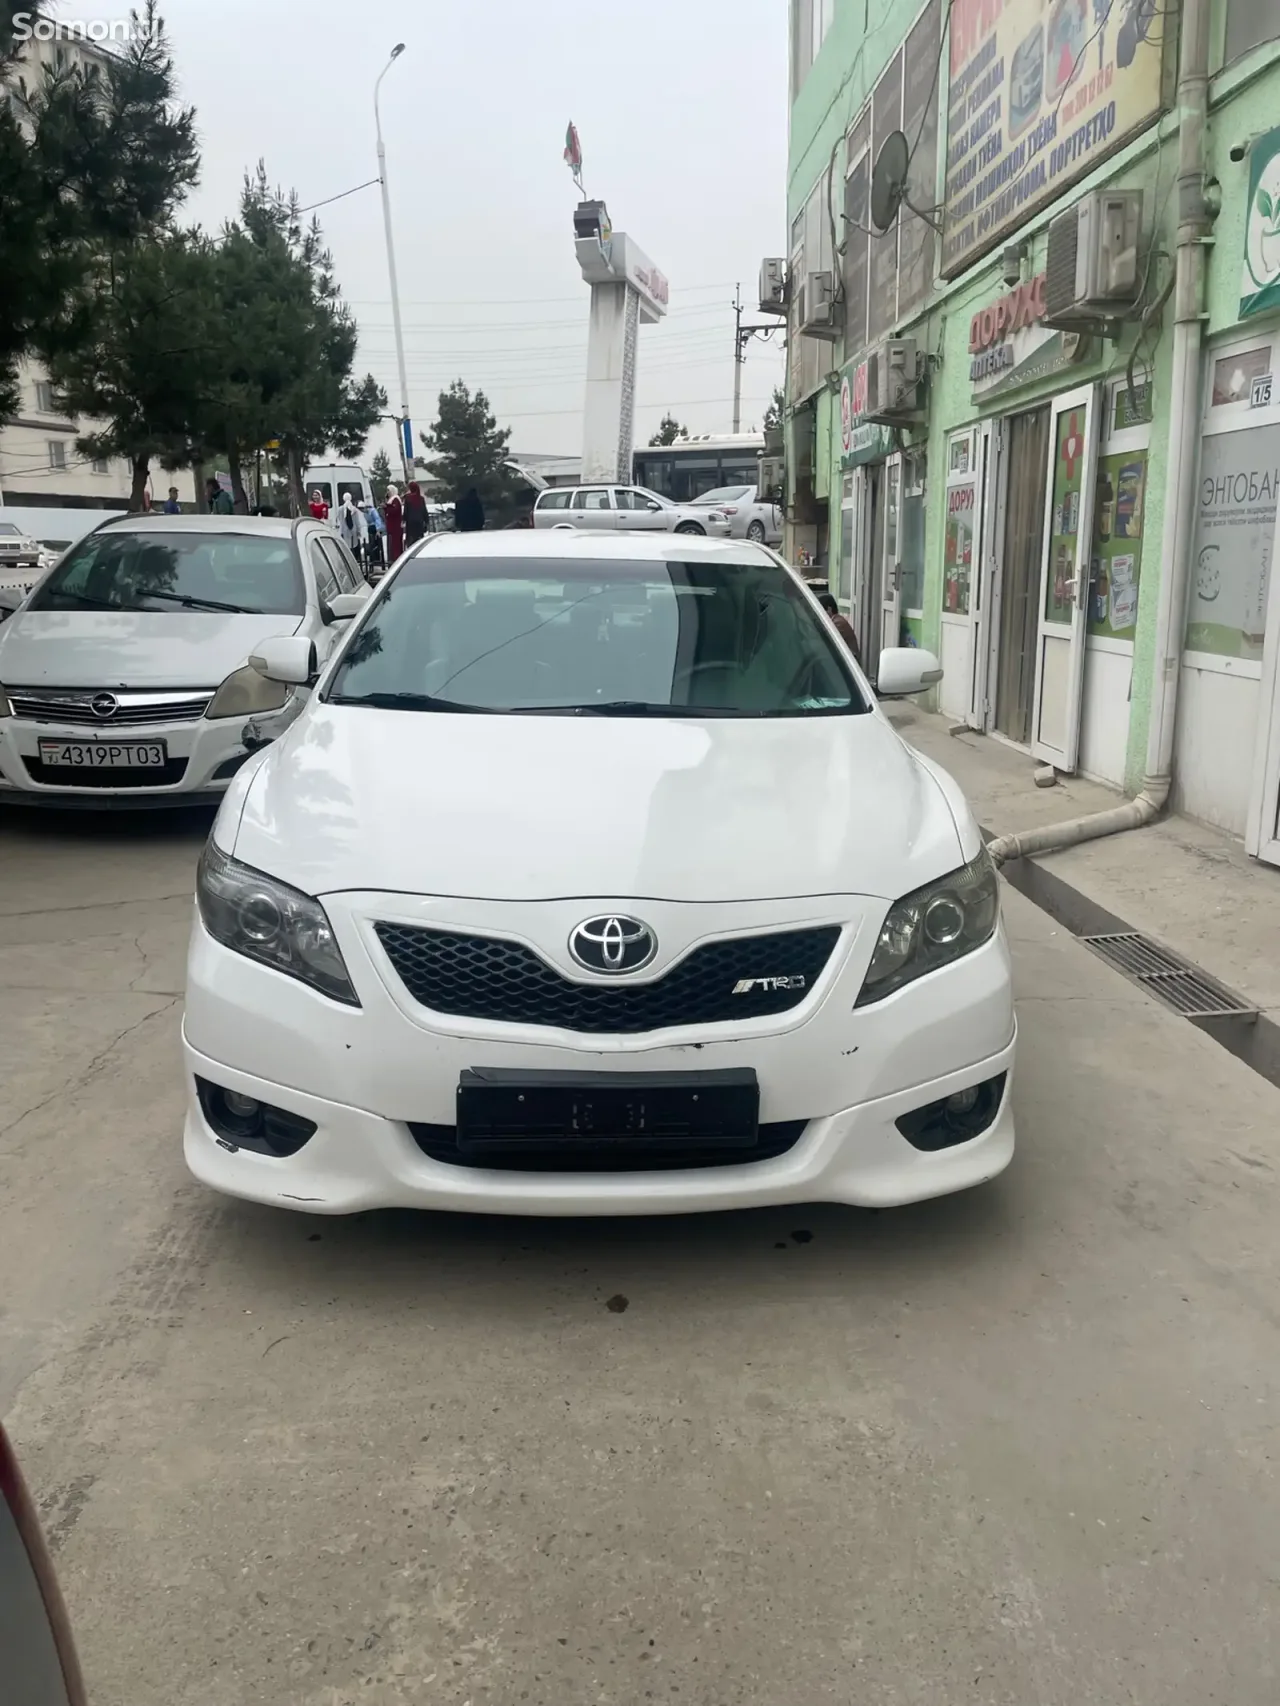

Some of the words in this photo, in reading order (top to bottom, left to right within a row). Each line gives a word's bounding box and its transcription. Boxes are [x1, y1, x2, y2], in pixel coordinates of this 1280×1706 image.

[970, 346, 1008, 380] АПТЕКА
[1254, 384, 1271, 403] 1/5
[62, 746, 161, 765] 4319PT03
[756, 975, 805, 991] TRD
